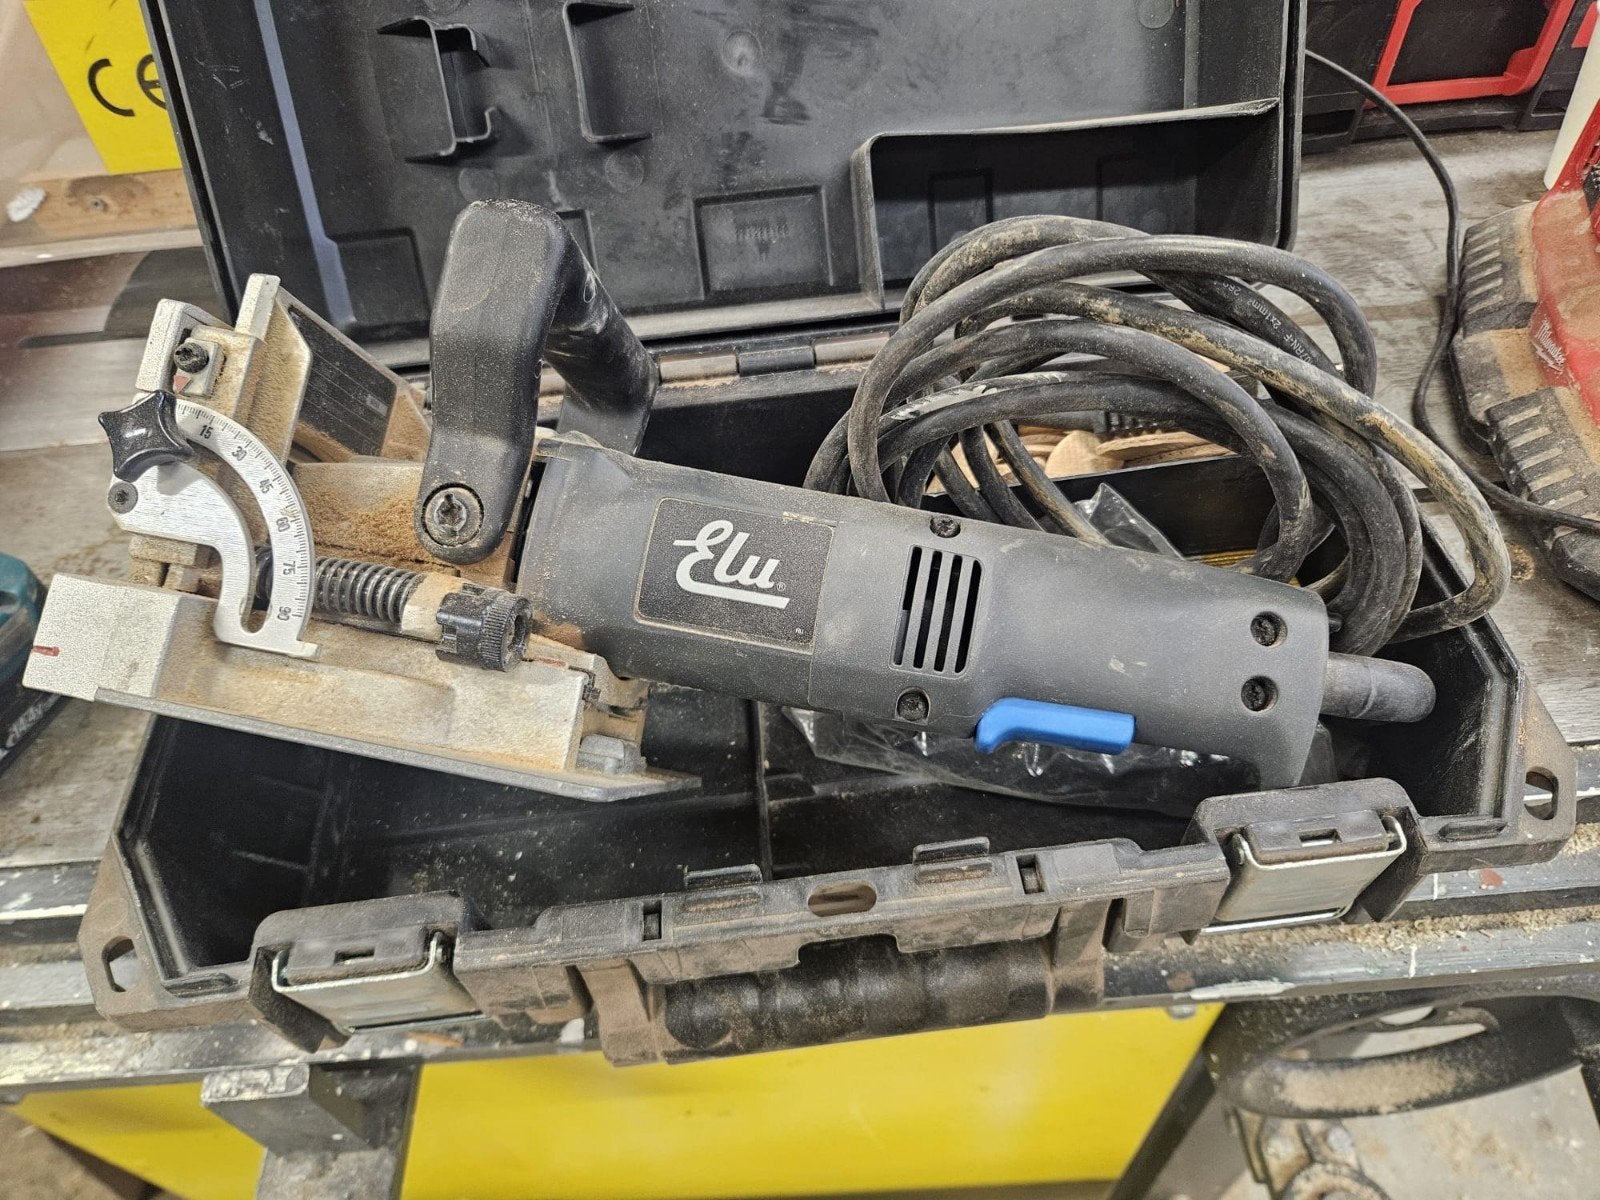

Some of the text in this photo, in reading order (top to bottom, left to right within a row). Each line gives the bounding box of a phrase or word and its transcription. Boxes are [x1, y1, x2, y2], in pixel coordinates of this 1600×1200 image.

[200, 424, 212, 439] 15
[231, 446, 248, 461] 30
[259, 478, 275, 495] 45
[276, 517, 291, 533] 60
[283, 561, 296, 576] 75
[673, 520, 790, 609] Elu
[277, 606, 292, 622] 90
